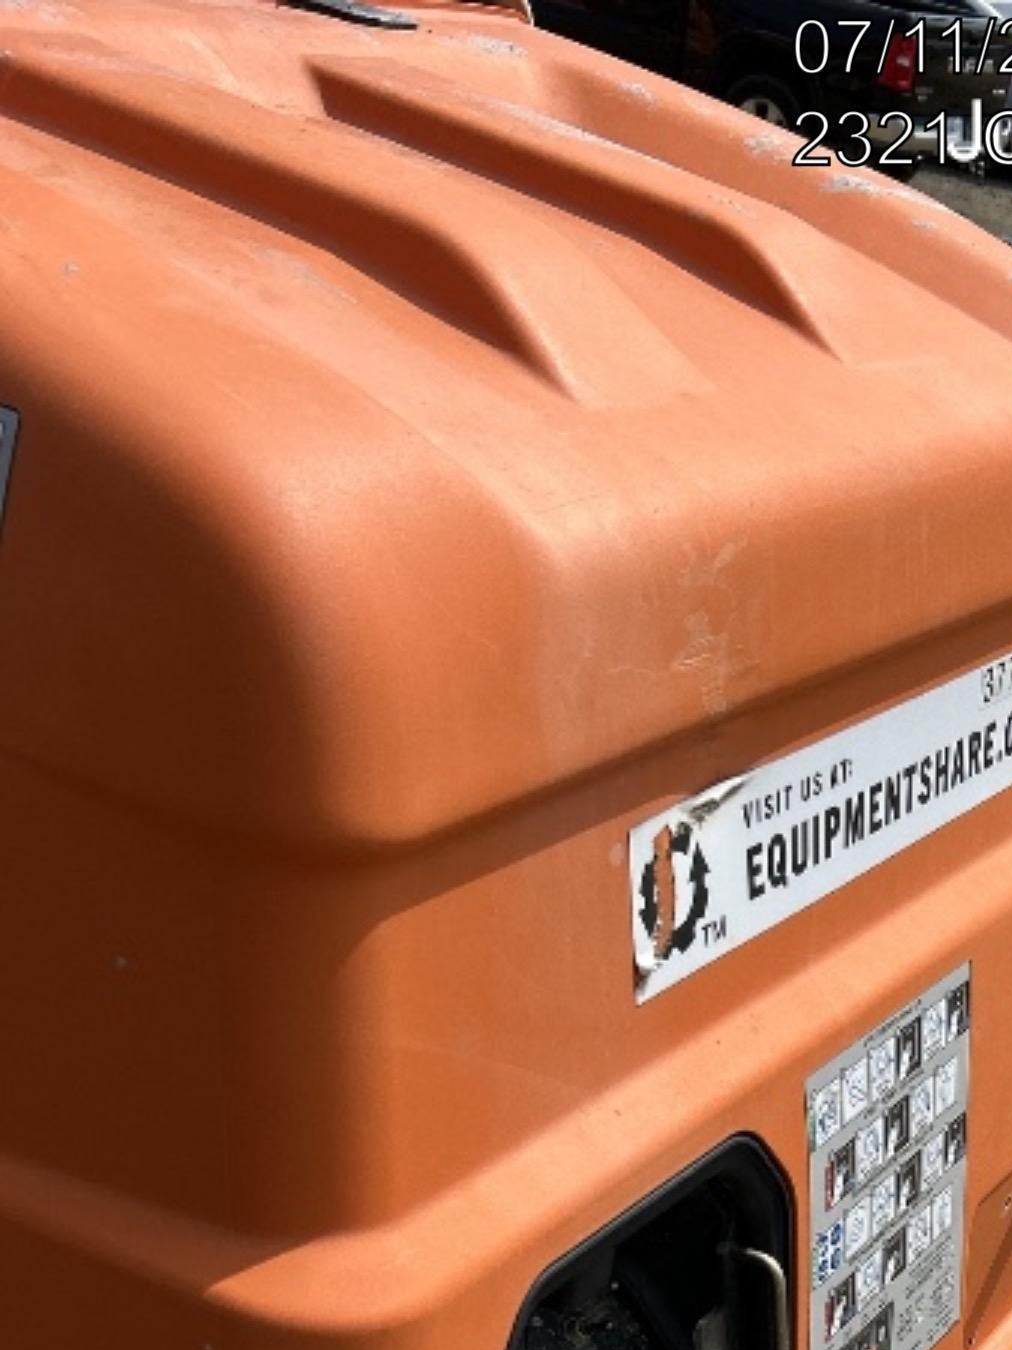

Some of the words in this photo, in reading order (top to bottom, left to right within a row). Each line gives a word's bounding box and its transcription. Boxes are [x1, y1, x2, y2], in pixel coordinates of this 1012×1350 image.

[743, 784, 793, 829] VISIT
[801, 771, 822, 802] US
[830, 758, 853, 789] AT:
